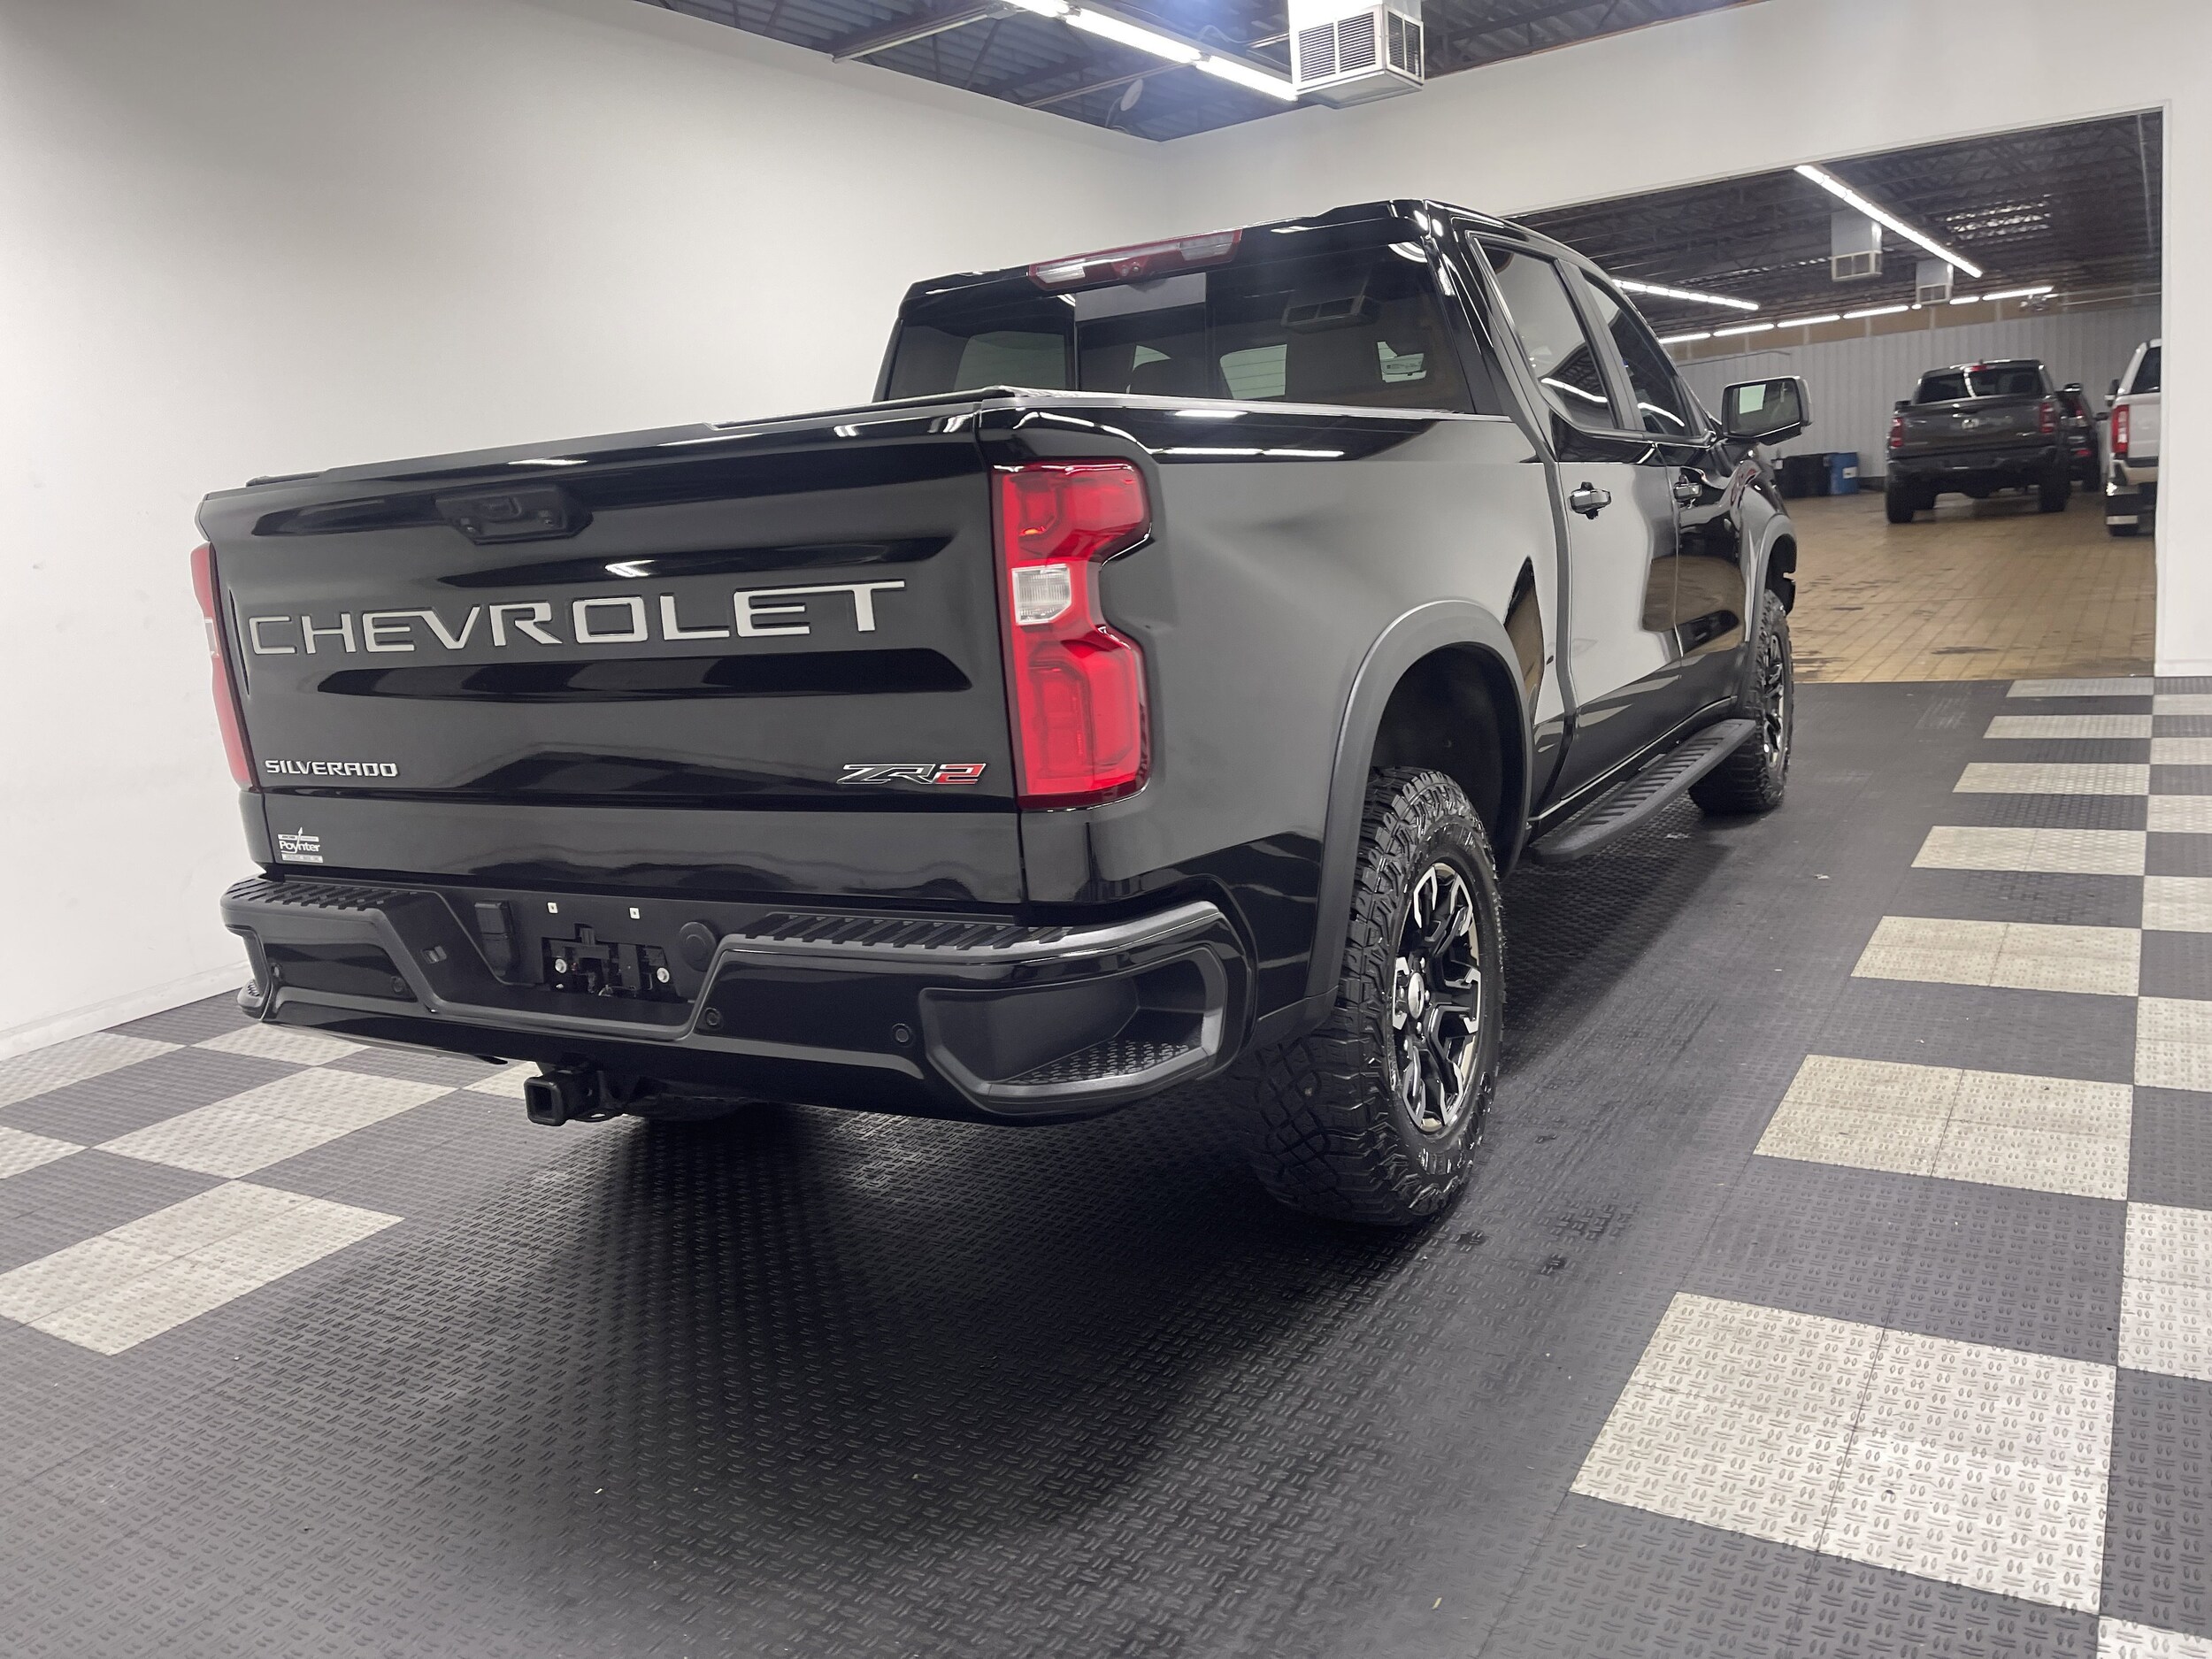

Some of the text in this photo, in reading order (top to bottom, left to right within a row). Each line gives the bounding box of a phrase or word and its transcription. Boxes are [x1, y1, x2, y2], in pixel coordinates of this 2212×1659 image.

[249, 580, 905, 655] CHEVROLET
[265, 759, 398, 777] SILVERADO
[836, 763, 987, 785] ZR2
[279, 839, 320, 853] Poynter
